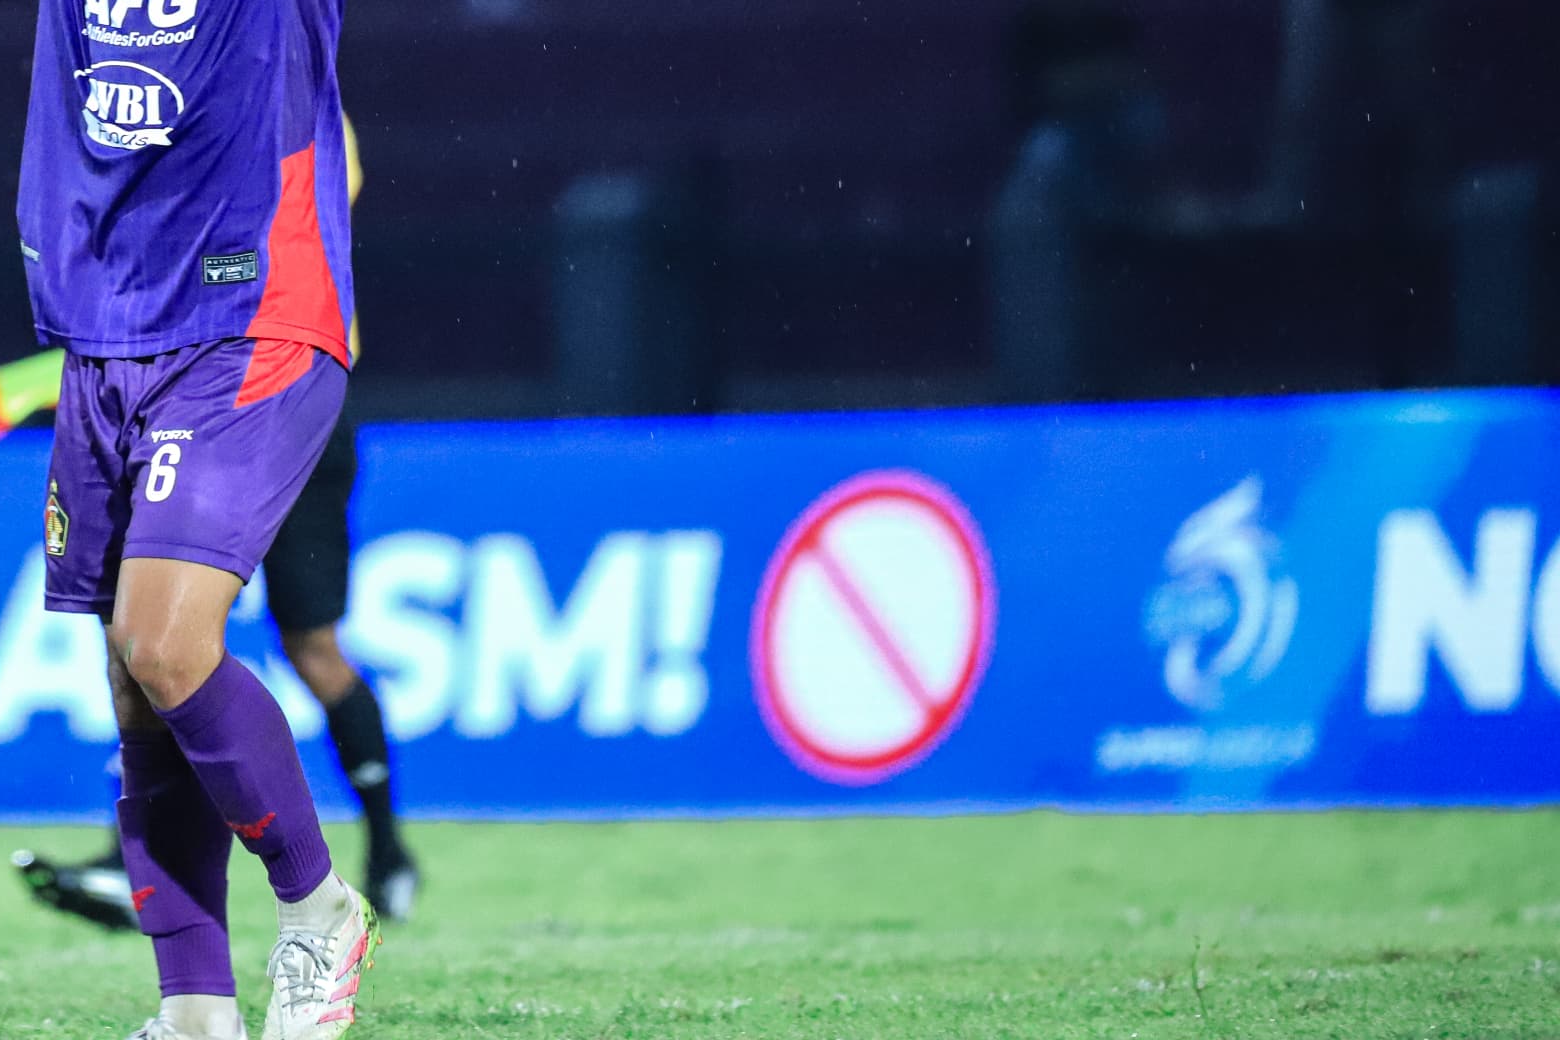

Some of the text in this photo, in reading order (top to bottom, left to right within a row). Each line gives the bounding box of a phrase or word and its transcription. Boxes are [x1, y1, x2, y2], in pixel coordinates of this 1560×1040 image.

[85, 78, 162, 125] WBI
[144, 443, 182, 502] 6
[1364, 506, 1560, 716] N
